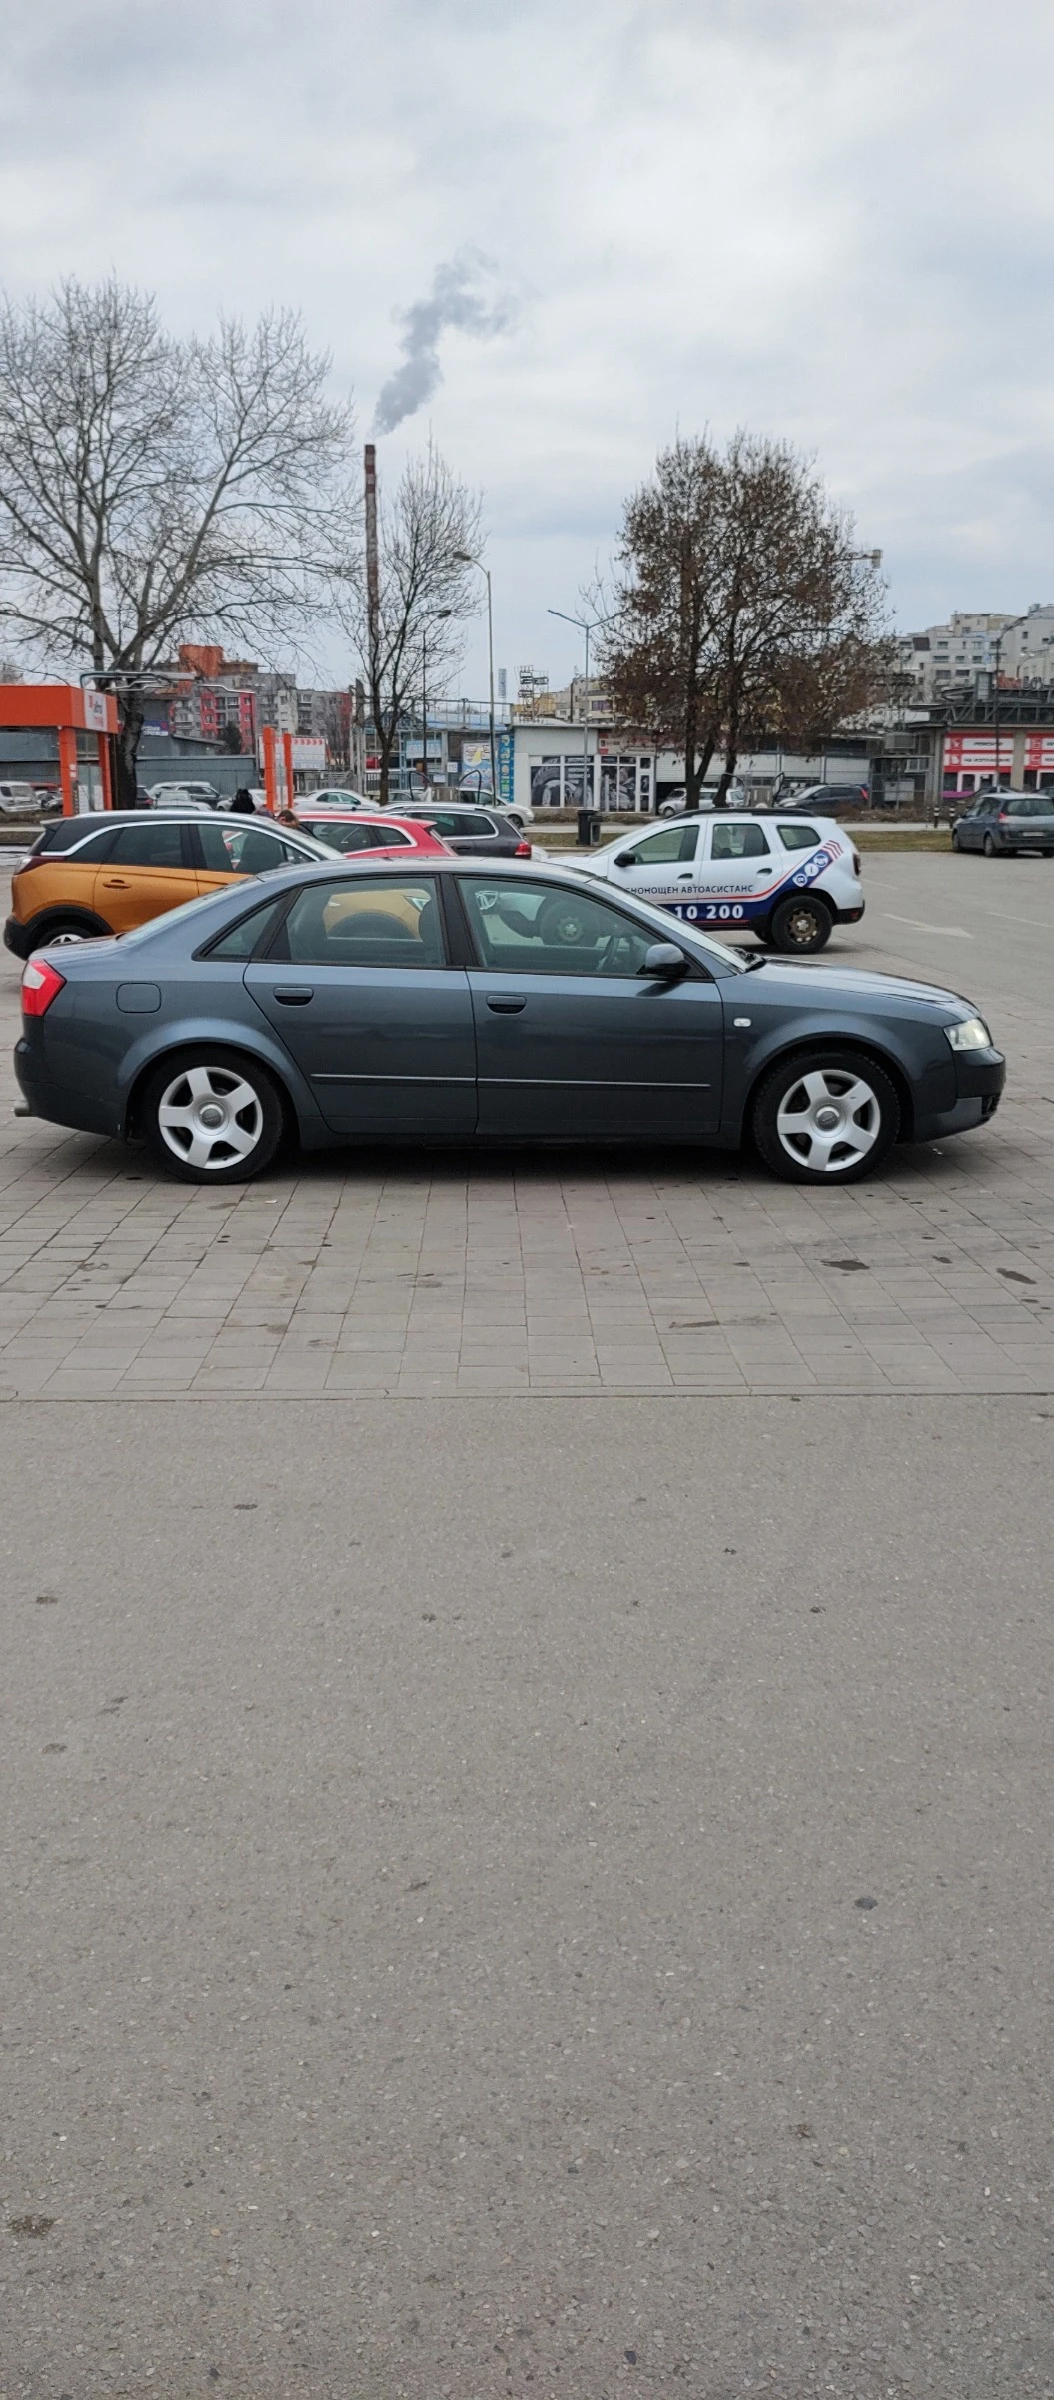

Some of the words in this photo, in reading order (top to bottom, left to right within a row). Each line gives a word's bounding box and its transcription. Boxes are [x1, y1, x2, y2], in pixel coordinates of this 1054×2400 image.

[681, 885, 754, 894] АВТОАСИСТАНС
[675, 905, 698, 920] 10
[706, 904, 744, 919] 200
